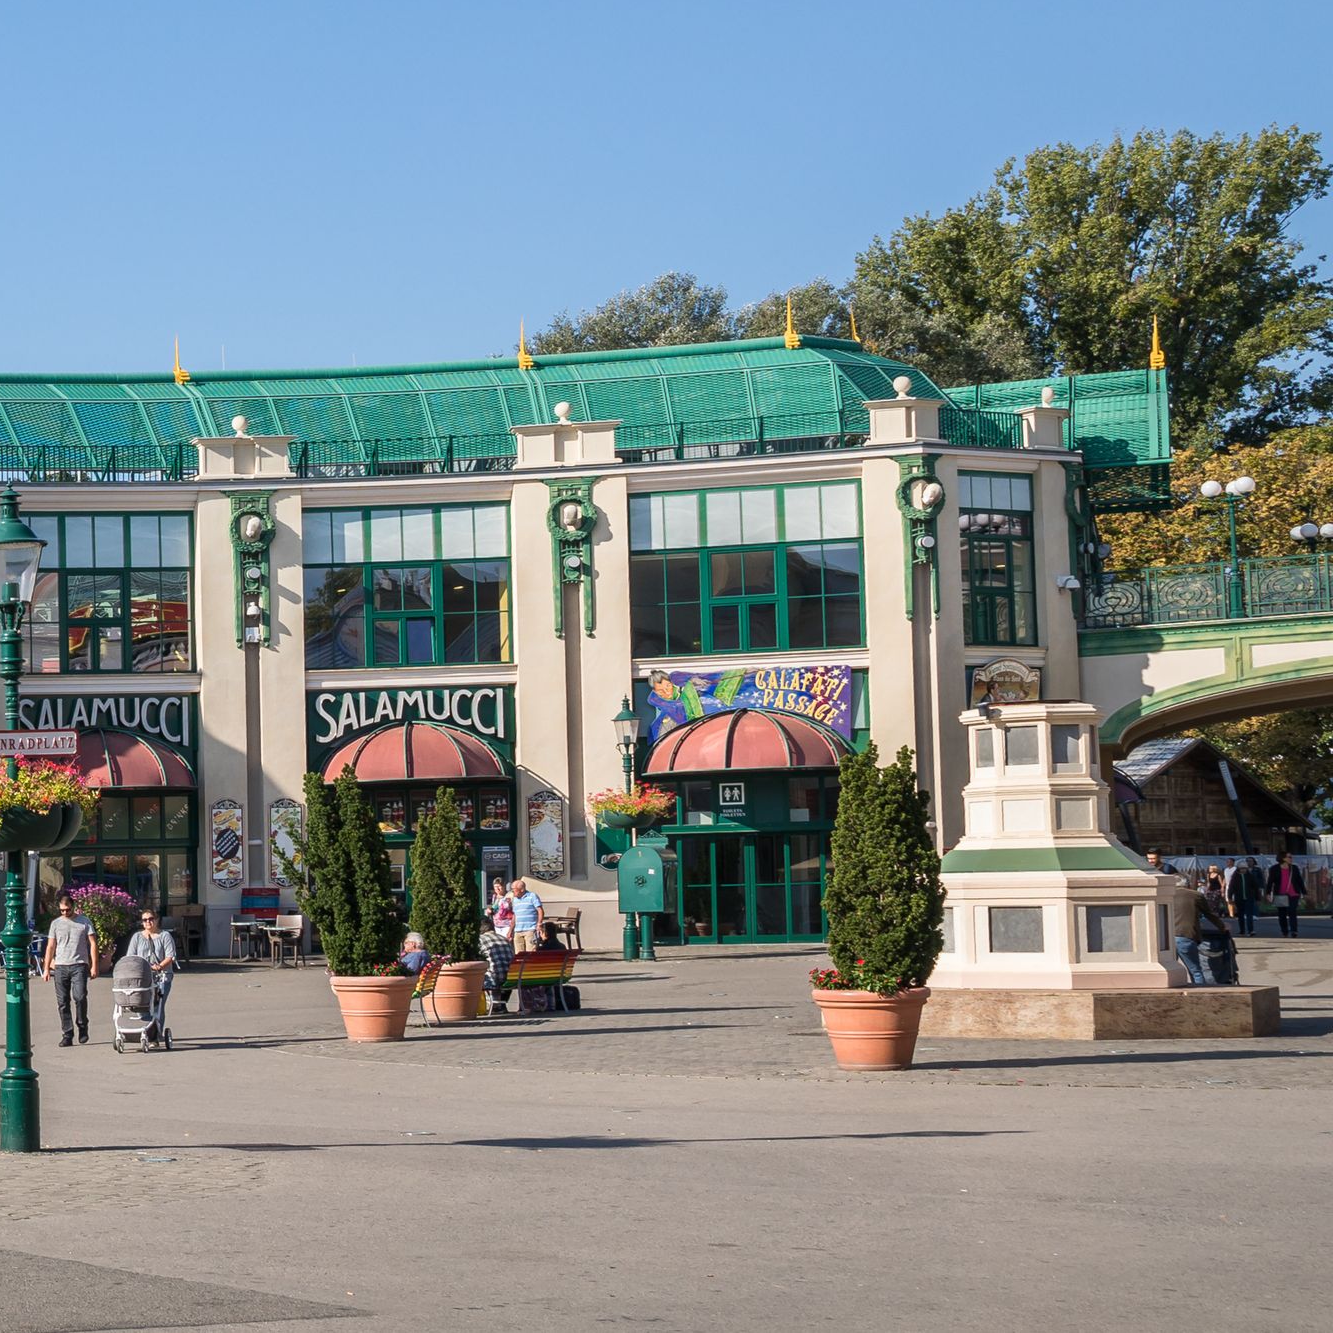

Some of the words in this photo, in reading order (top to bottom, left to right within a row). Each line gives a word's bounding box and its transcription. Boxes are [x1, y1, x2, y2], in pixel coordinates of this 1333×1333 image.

[19, 696, 189, 747] SALAMUCCI
[315, 687, 504, 744] SALAMUCCI
[763, 689, 839, 726] PASSAGE
